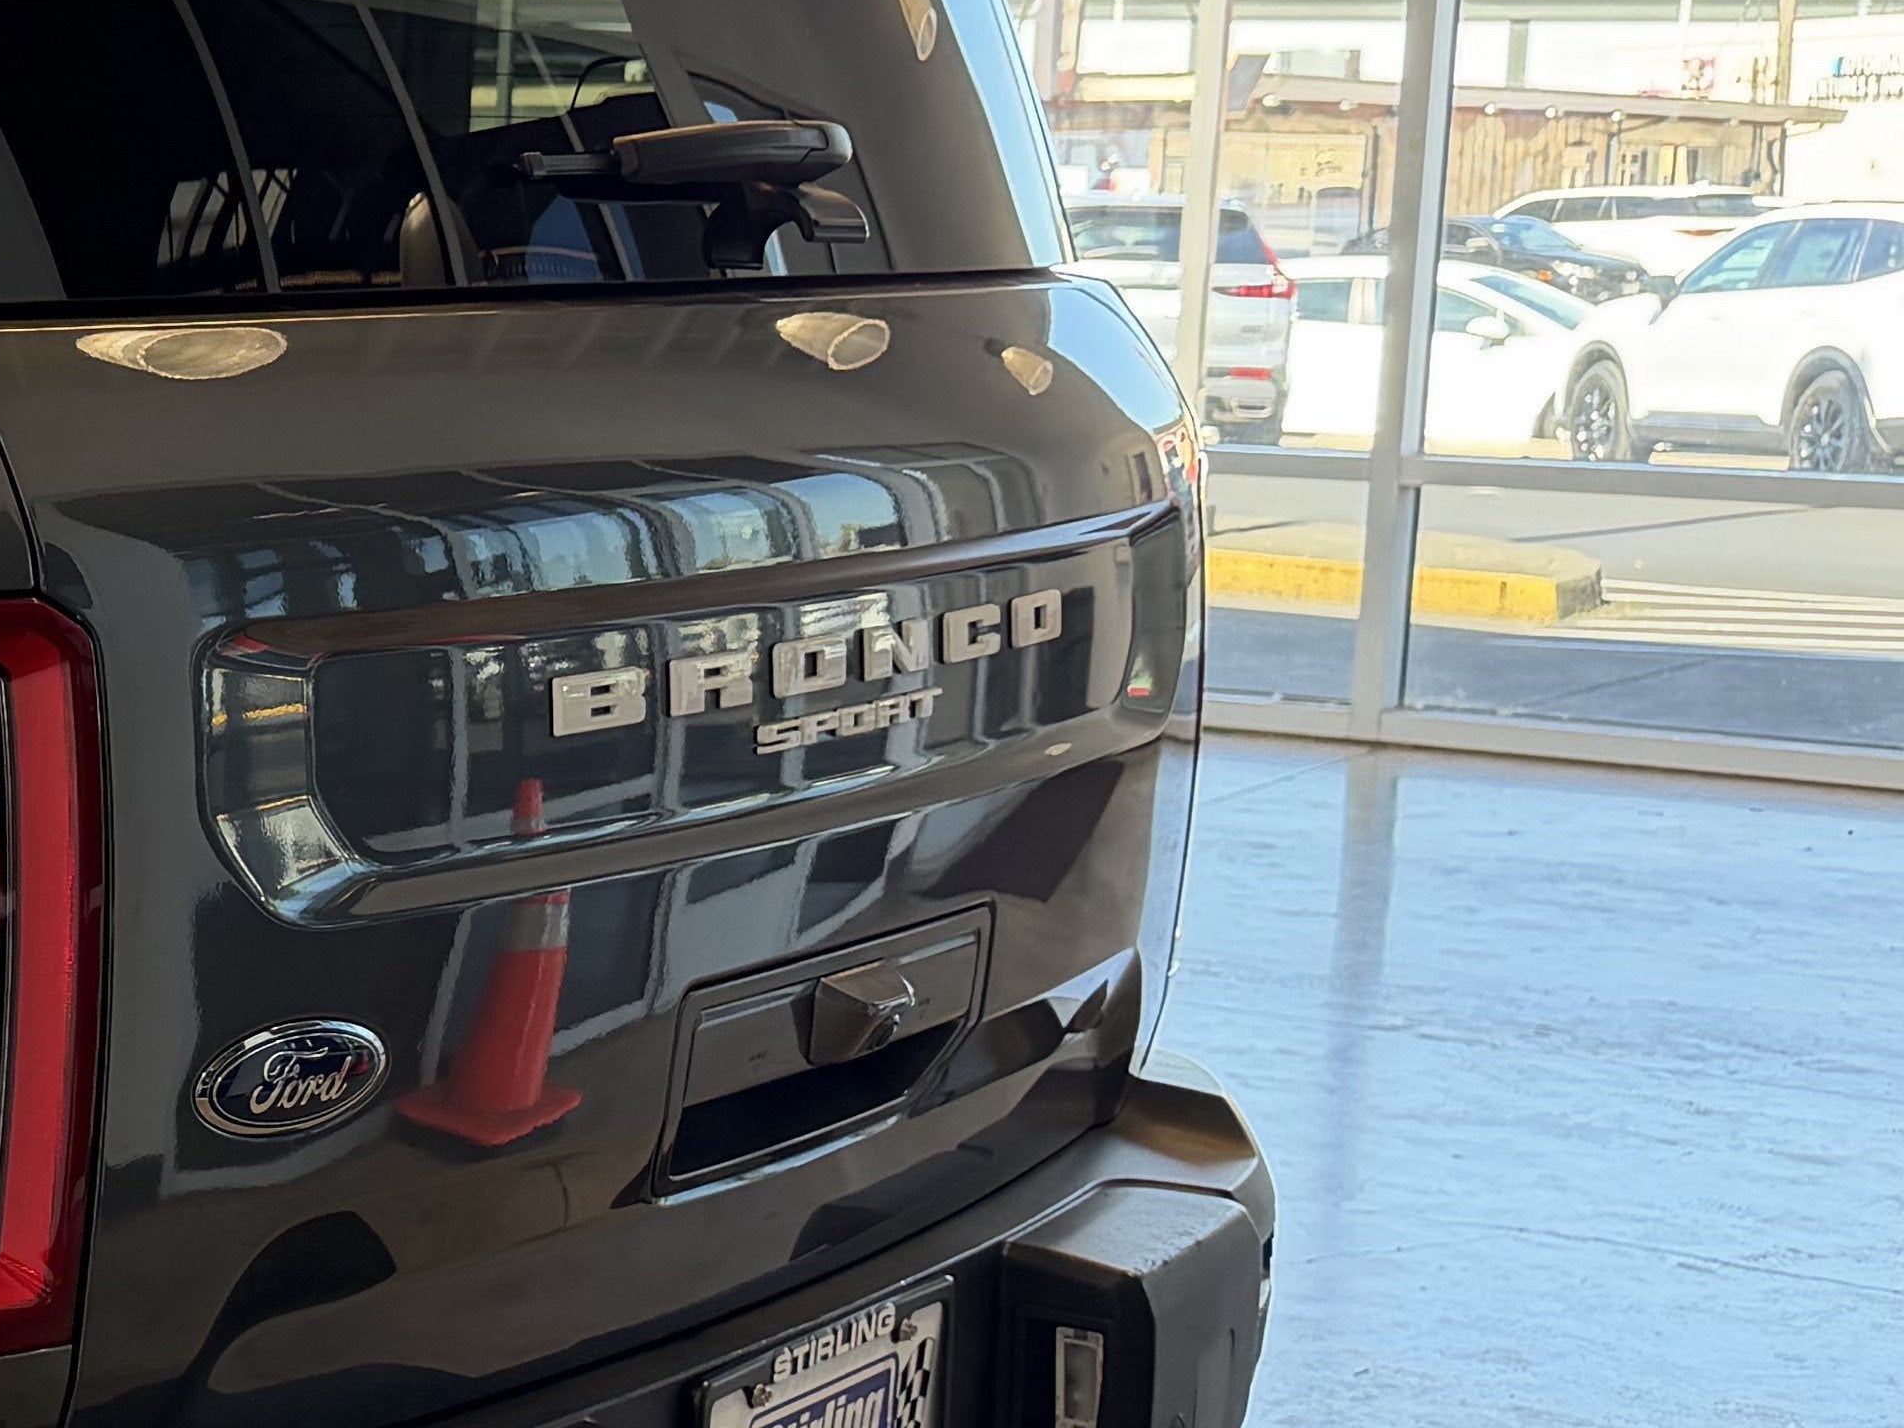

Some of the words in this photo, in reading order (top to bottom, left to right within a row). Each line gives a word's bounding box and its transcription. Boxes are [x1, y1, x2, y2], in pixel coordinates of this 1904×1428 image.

[551, 588, 1062, 737] BRONCO
[755, 686, 943, 755] SPORT
[249, 1047, 353, 1114] Ford
[772, 1302, 897, 1383] STIRLING
